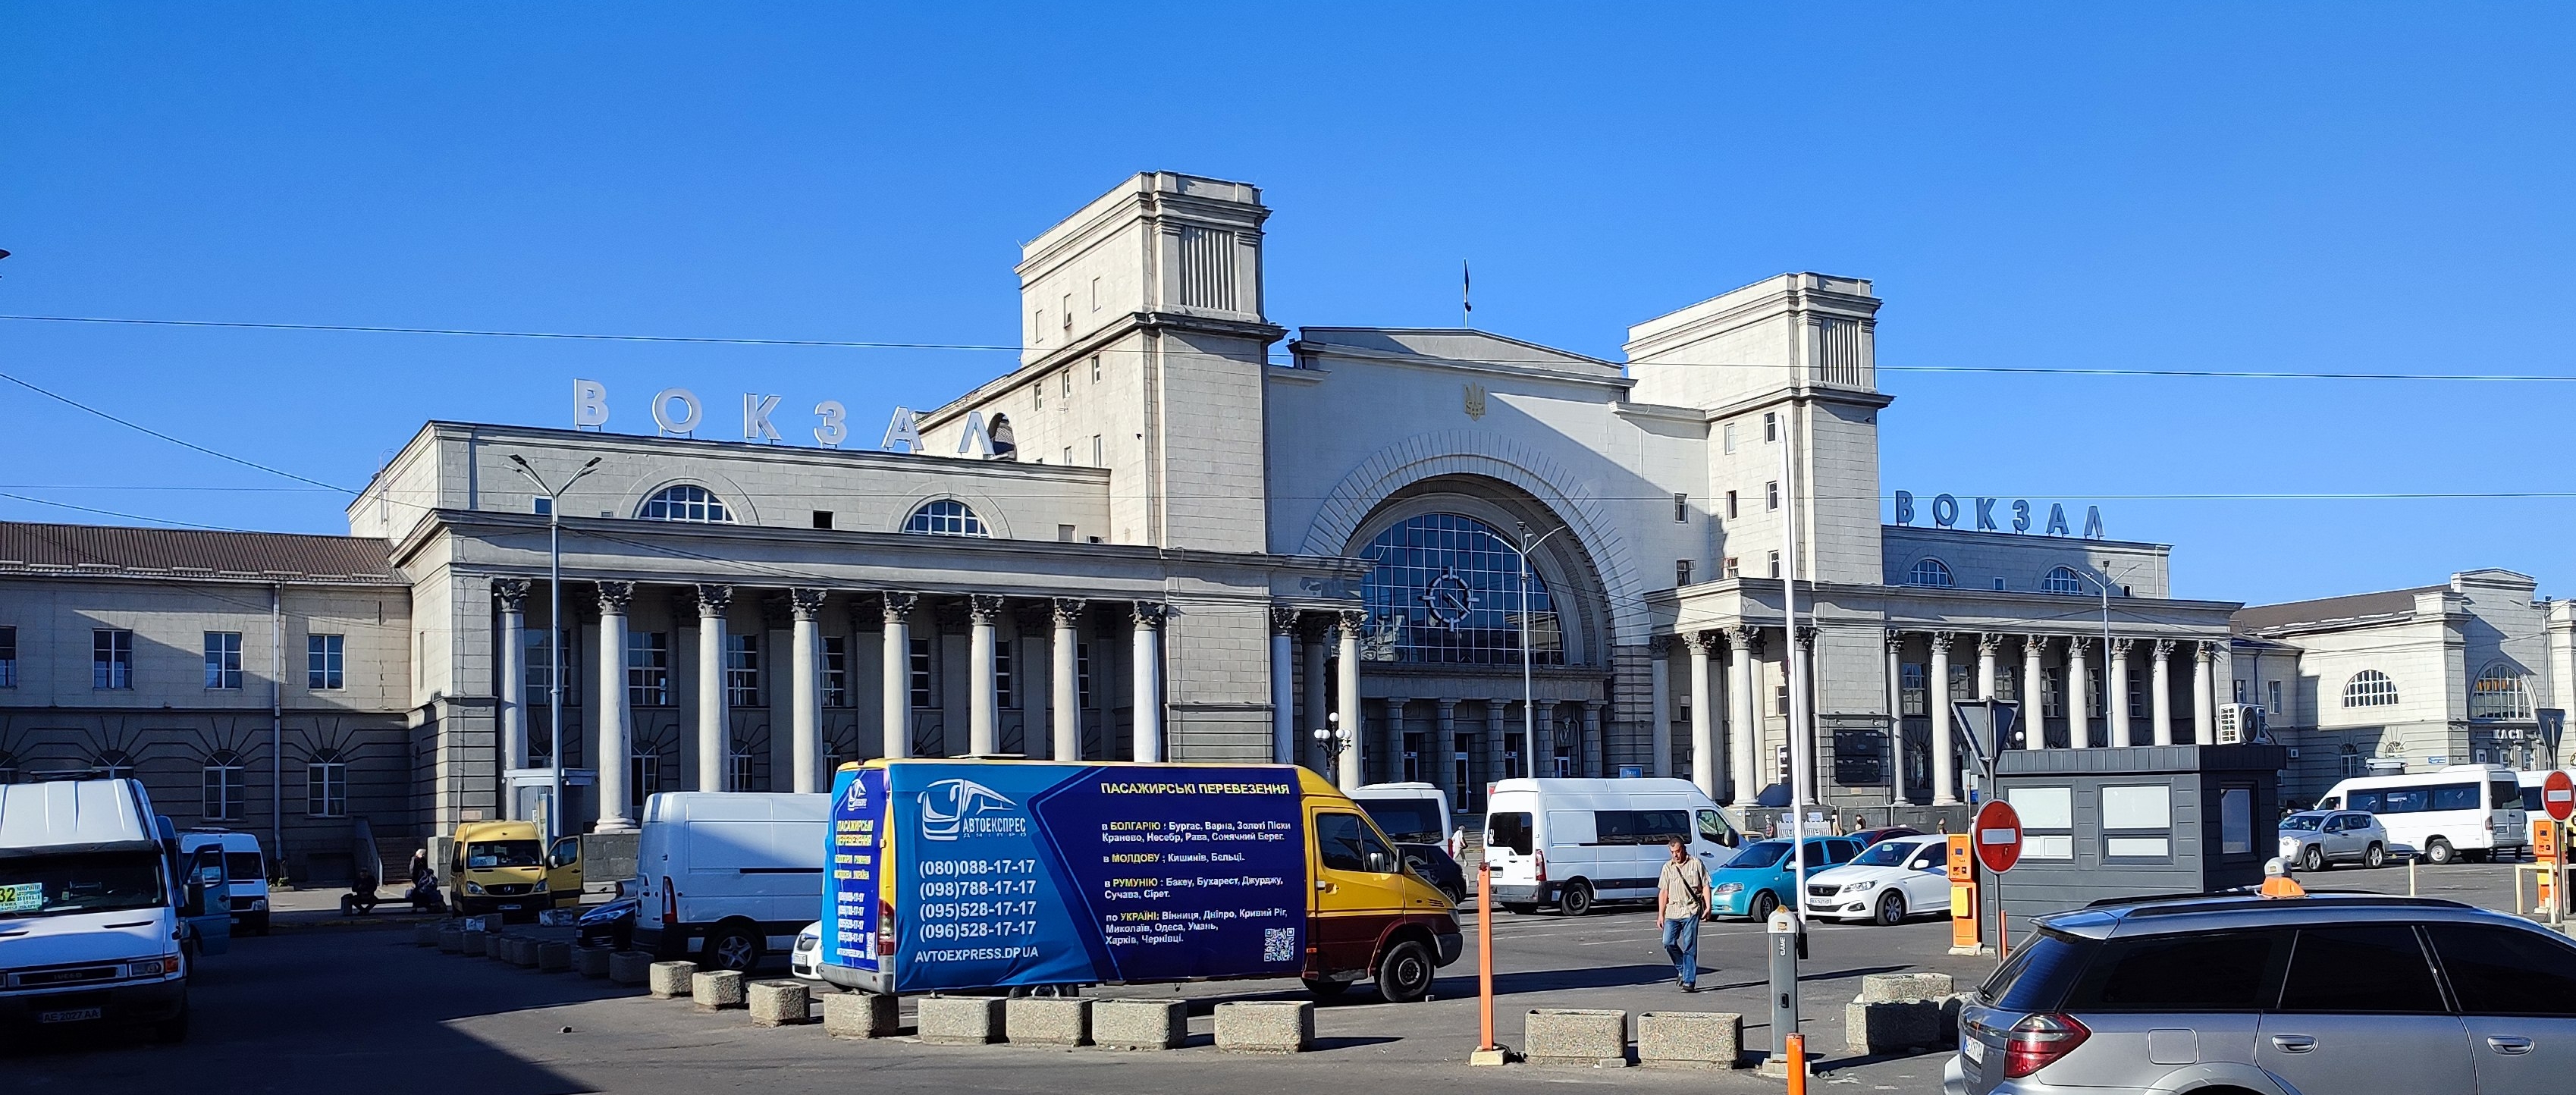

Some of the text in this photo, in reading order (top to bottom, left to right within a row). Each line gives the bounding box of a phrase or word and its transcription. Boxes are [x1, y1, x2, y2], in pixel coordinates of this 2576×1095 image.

[574, 378, 996, 455] ВОКЗАЛ
[1895, 490, 2106, 537] ВОКЗАЛ
[1100, 783, 1291, 795] ПАСАЖИРСЬКІ ПЕРЕВЕЗЕННЯ
[962, 817, 1026, 833] АВТОЕКСПРЕС
[1110, 821, 1161, 831] БОЛГАРІЮ
[1236, 820, 1266, 830] Золоті
[1211, 832, 1256, 841] Сонячний
[1112, 853, 1160, 864] МОЛДОВУ
[1168, 853, 1210, 863] Кишинів,
[920, 859, 1036, 879] (080)088-17-17
[1112, 877, 1159, 887] РУМУНІЮ
[1197, 877, 1241, 888] Бухарест,
[920, 880, 1037, 901] (098)788-17-17
[1104, 889, 1141, 901] Сучава,
[920, 901, 1037, 922] (095)528-17-17
[1162, 911, 1201, 921] Вінниця,
[1203, 908, 1238, 921] Дніпро,
[1239, 908, 1272, 919] Кривий
[920, 921, 1037, 943] (096)528-17-17
[1106, 921, 1219, 933] Миколаїв, Одеса, Умань,
[1141, 933, 1184, 945] Чернівці.
[44, 1009, 99, 1022] AE 2027 AA
